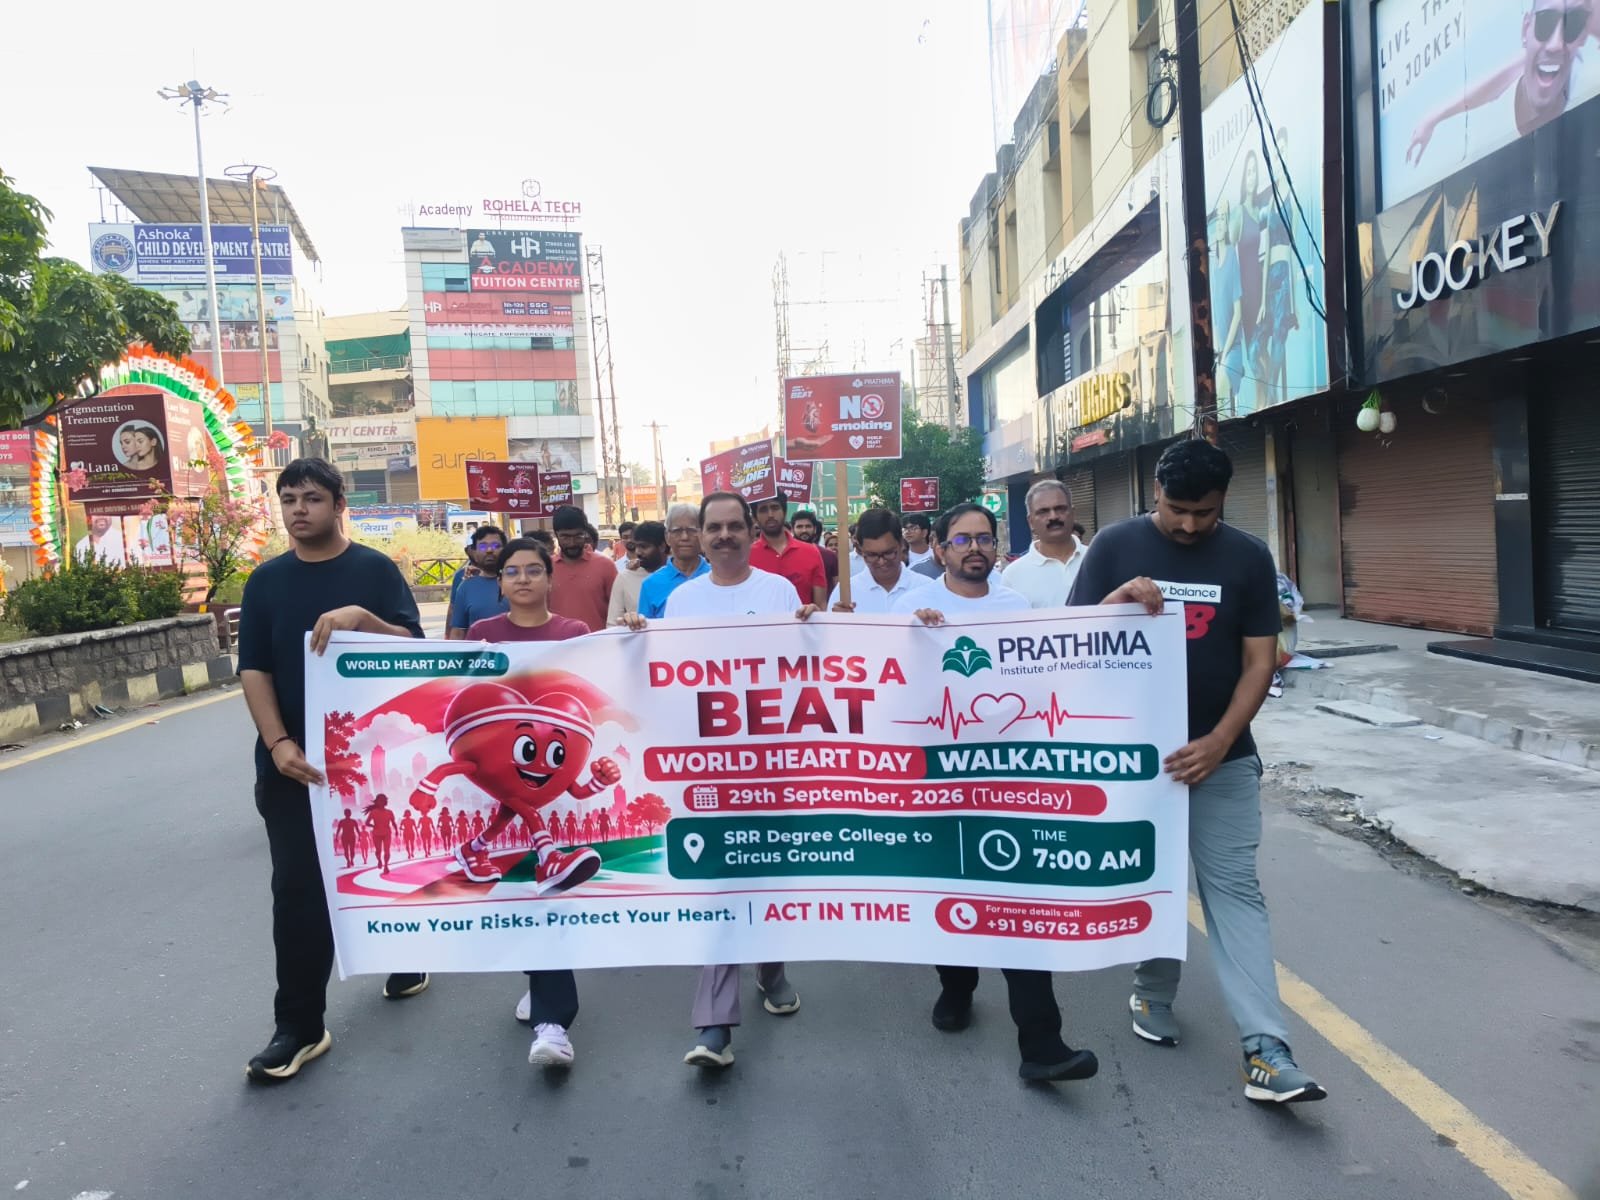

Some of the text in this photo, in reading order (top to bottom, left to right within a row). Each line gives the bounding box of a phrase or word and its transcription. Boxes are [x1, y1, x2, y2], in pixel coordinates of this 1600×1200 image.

[1381, 0, 1449, 69] LIVE TH
[1382, 11, 1461, 110] IN JOCKEY
[419, 204, 472, 216] Academy
[483, 199, 581, 213] ROHELA TECH
[137, 241, 170, 256] CHILD
[172, 241, 248, 256] DEVELPMENT
[511, 237, 541, 258] HR
[1397, 200, 1561, 309] JOCKEY
[477, 256, 575, 274] ACADEMY
[472, 276, 581, 290] TUITION CENTRE
[424, 302, 442, 313] HR
[65, 415, 119, 425] Treatment
[831, 420, 893, 431] smoking
[325, 426, 398, 437] ITY CENTER
[432, 447, 496, 469] aurelia
[88, 462, 119, 473] Lana
[745, 468, 772, 482] DIET
[547, 484, 570, 492] HEART
[549, 493, 571, 502] DIET
[1170, 586, 1217, 598] balance
[998, 630, 1152, 662] PRATHIMA
[345, 658, 495, 671] WORLD HEART DAY 2026
[648, 655, 907, 687] DON'T MISS A
[1000, 659, 1153, 677] Institute of Medical Sciences
[697, 686, 875, 737] BEAT
[656, 748, 1142, 774] WORLD HEART DAY WALKATHON
[728, 786, 1073, 811] 29th September, 2026 (Tuesday)
[724, 828, 933, 847] SRR Degree College to
[1032, 829, 1068, 843] TIME
[725, 848, 855, 865] Circus Ground
[1032, 848, 1141, 871] 7:00 AM
[764, 902, 911, 922] ACT IN TIME
[985, 904, 1083, 918] For more details call:
[367, 907, 736, 934] Know Your Risks. Protect Your Heart.
[986, 917, 1139, 936] +91 96762 66525
